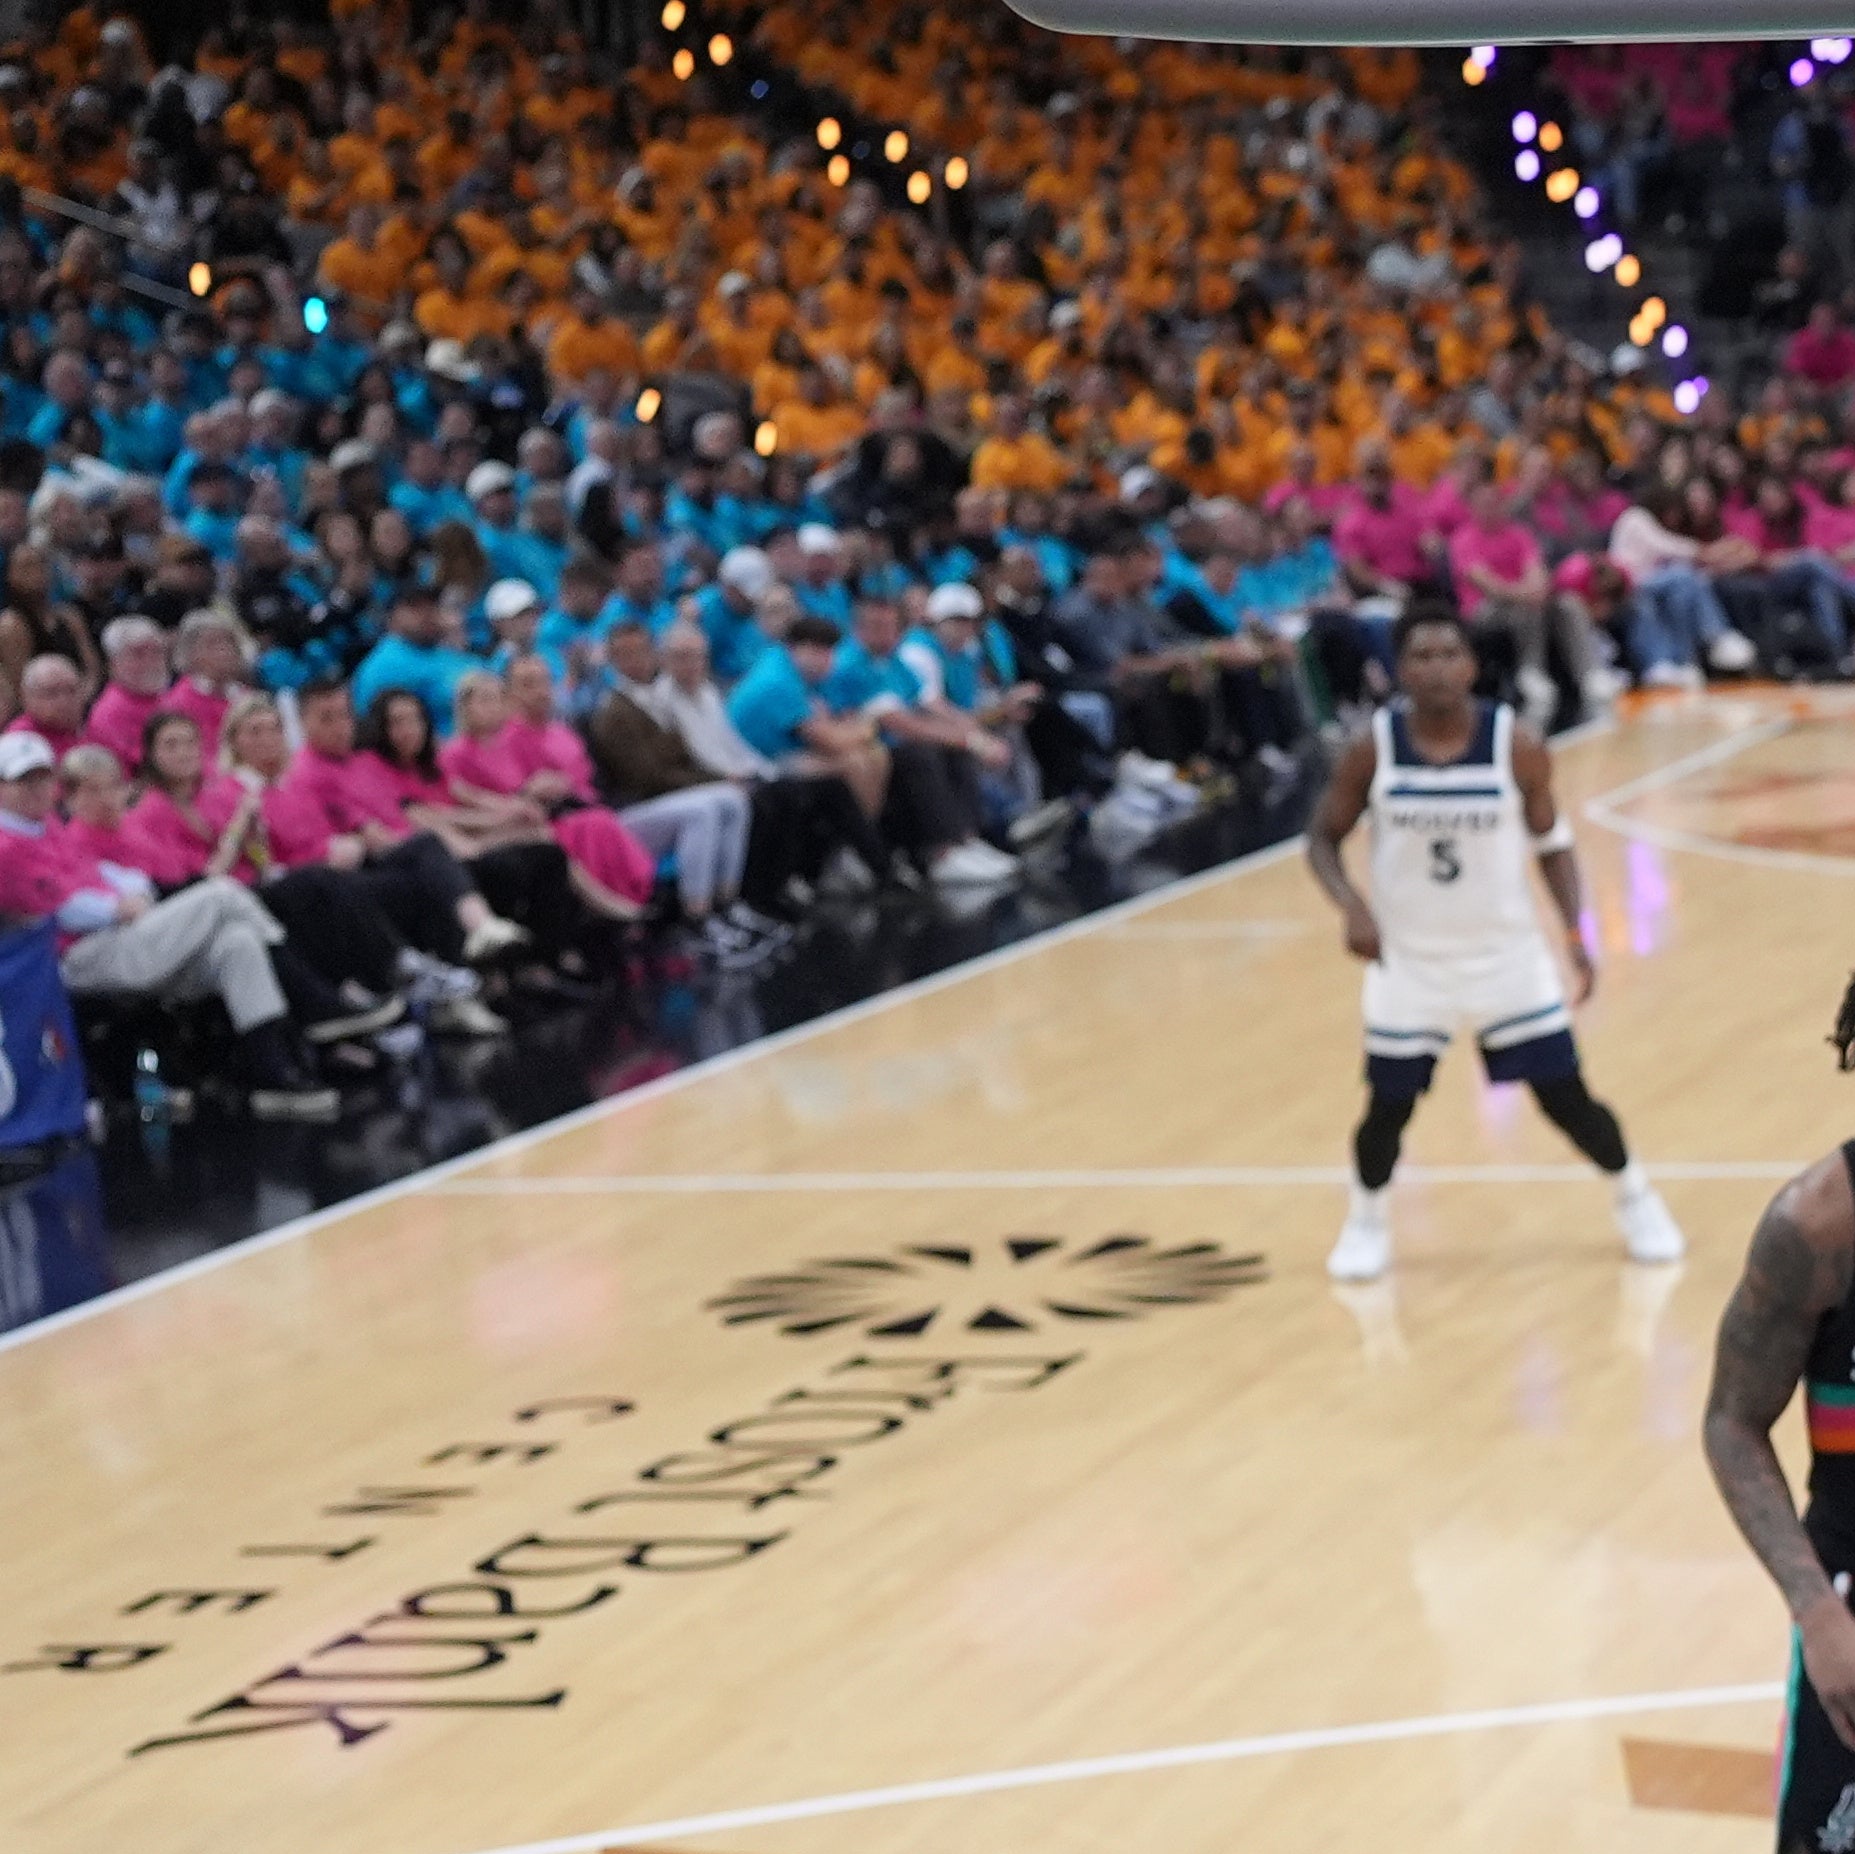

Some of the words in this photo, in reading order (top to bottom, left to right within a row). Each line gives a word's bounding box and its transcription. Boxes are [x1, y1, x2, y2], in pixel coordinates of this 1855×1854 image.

[1428, 837, 1462, 885] 5
[574, 1351, 1085, 1514] Frost
[3, 1397, 634, 1673] CENTER
[127, 1528, 790, 1758] Bank
